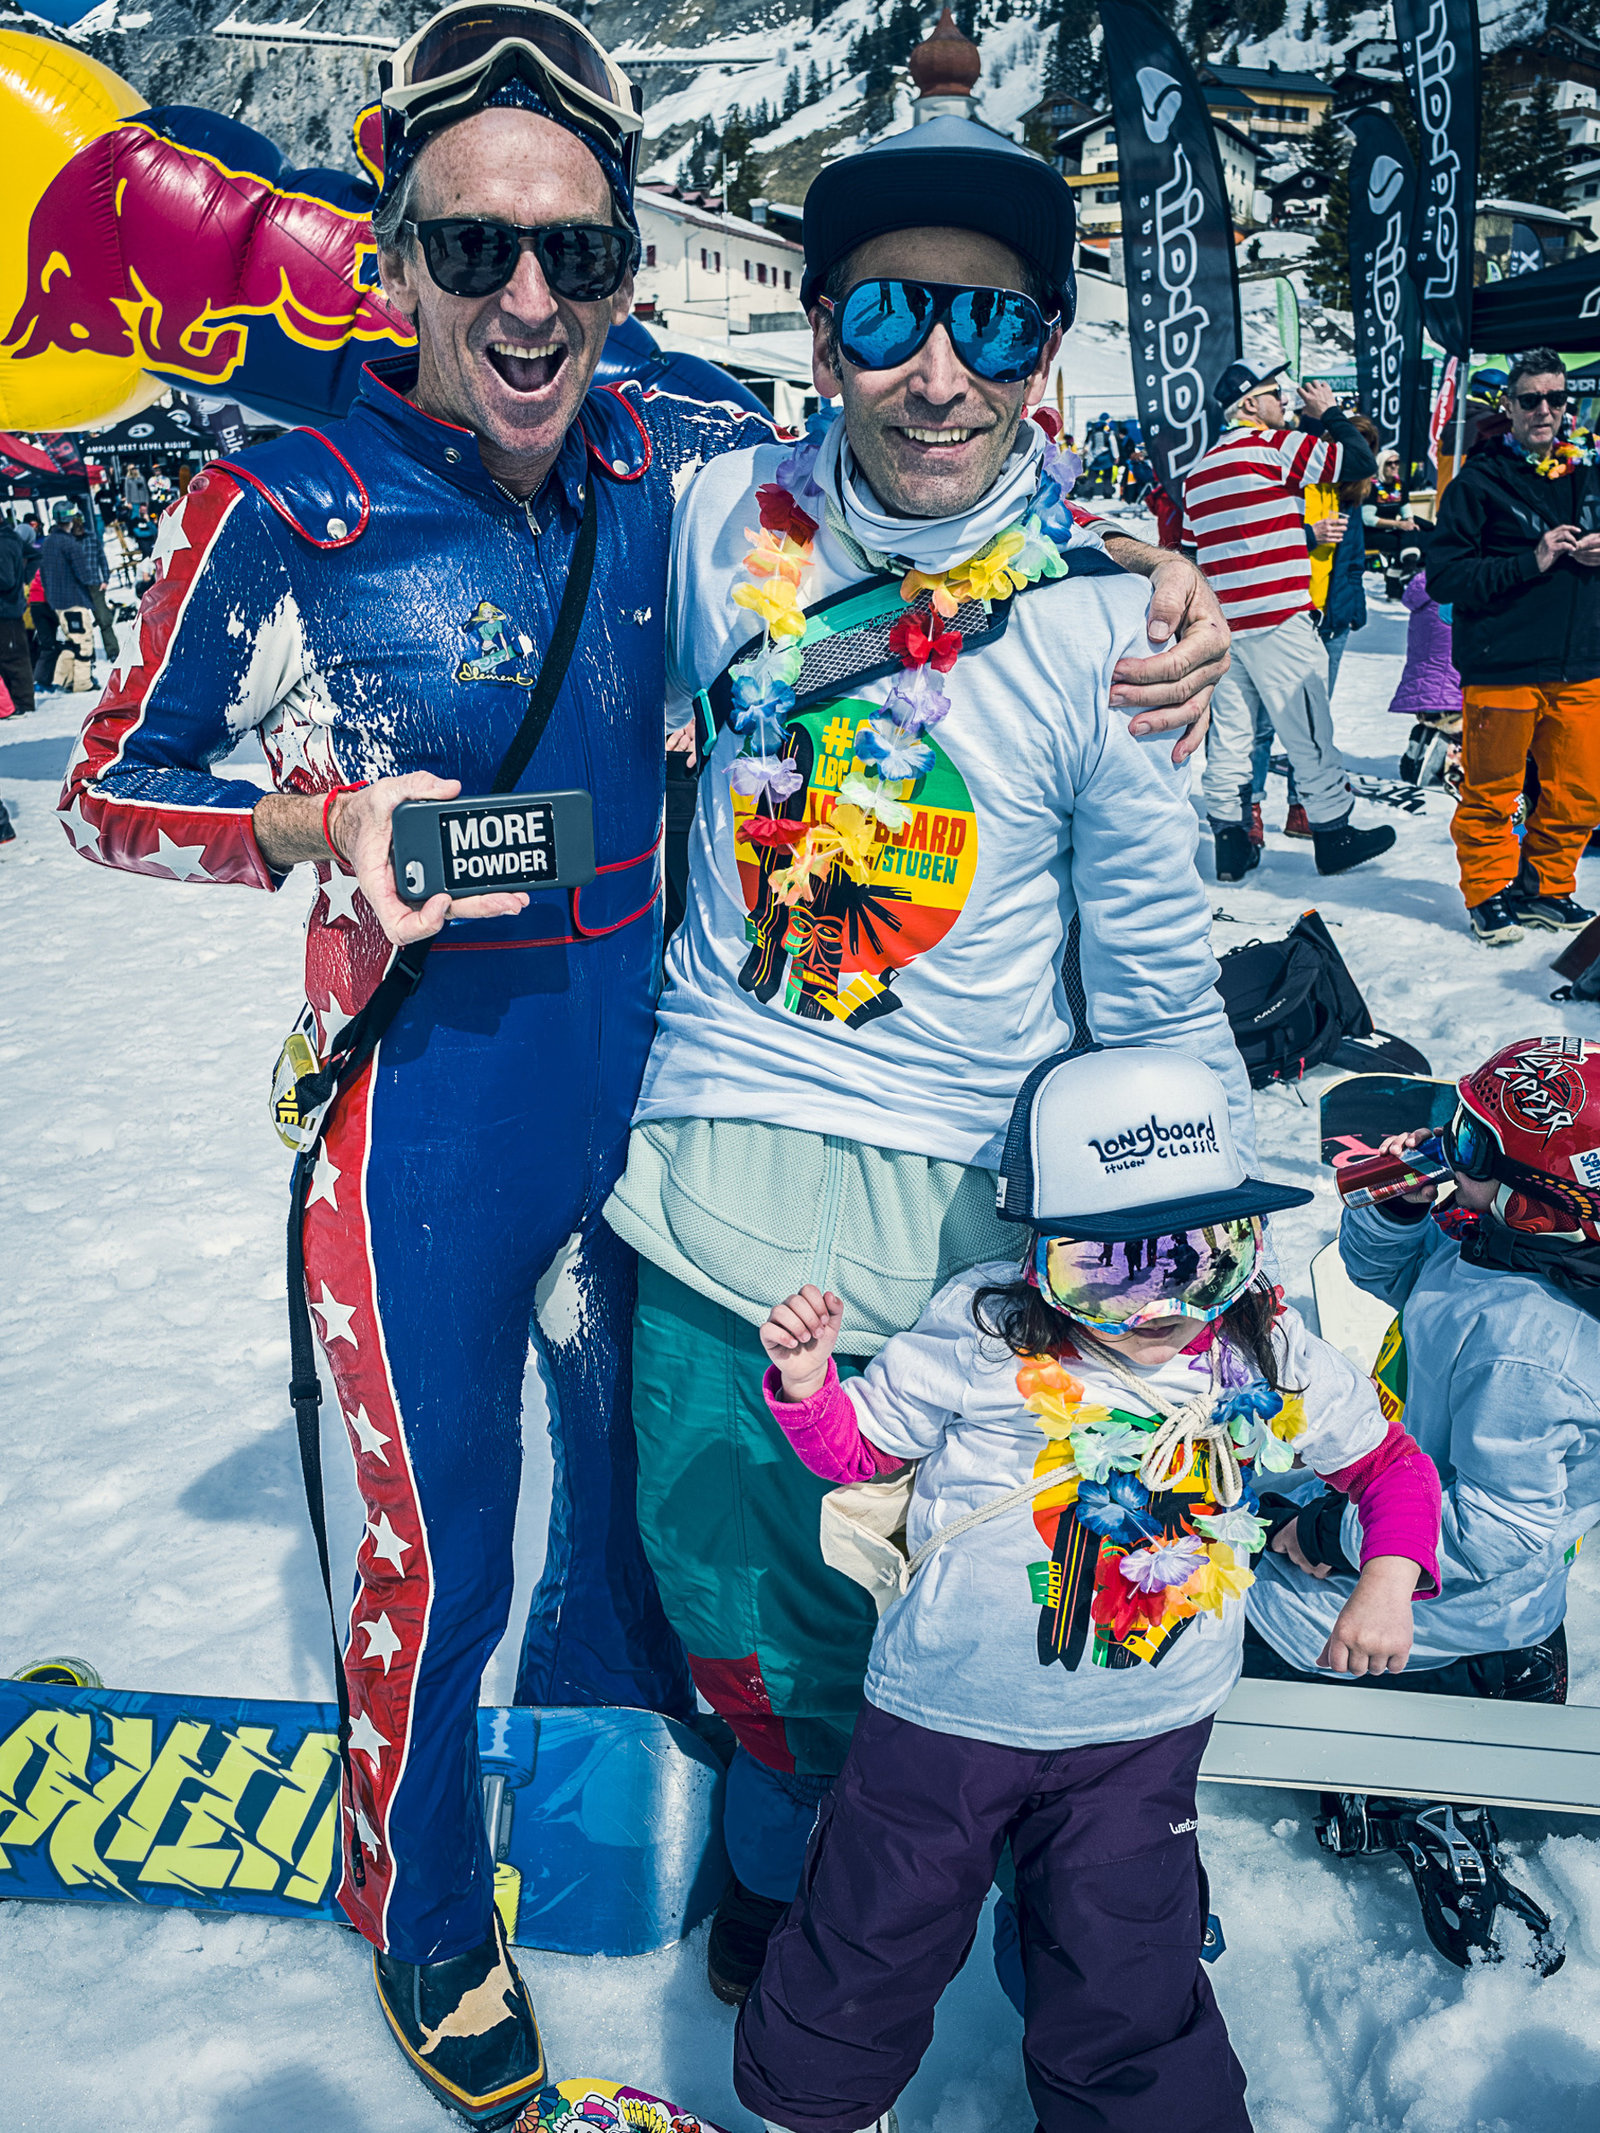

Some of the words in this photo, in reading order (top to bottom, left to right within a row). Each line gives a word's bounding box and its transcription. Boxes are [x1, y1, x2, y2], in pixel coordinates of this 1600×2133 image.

[458, 662, 534, 686] Element
[449, 810, 546, 853] MORE
[452, 849, 548, 880] POWDER
